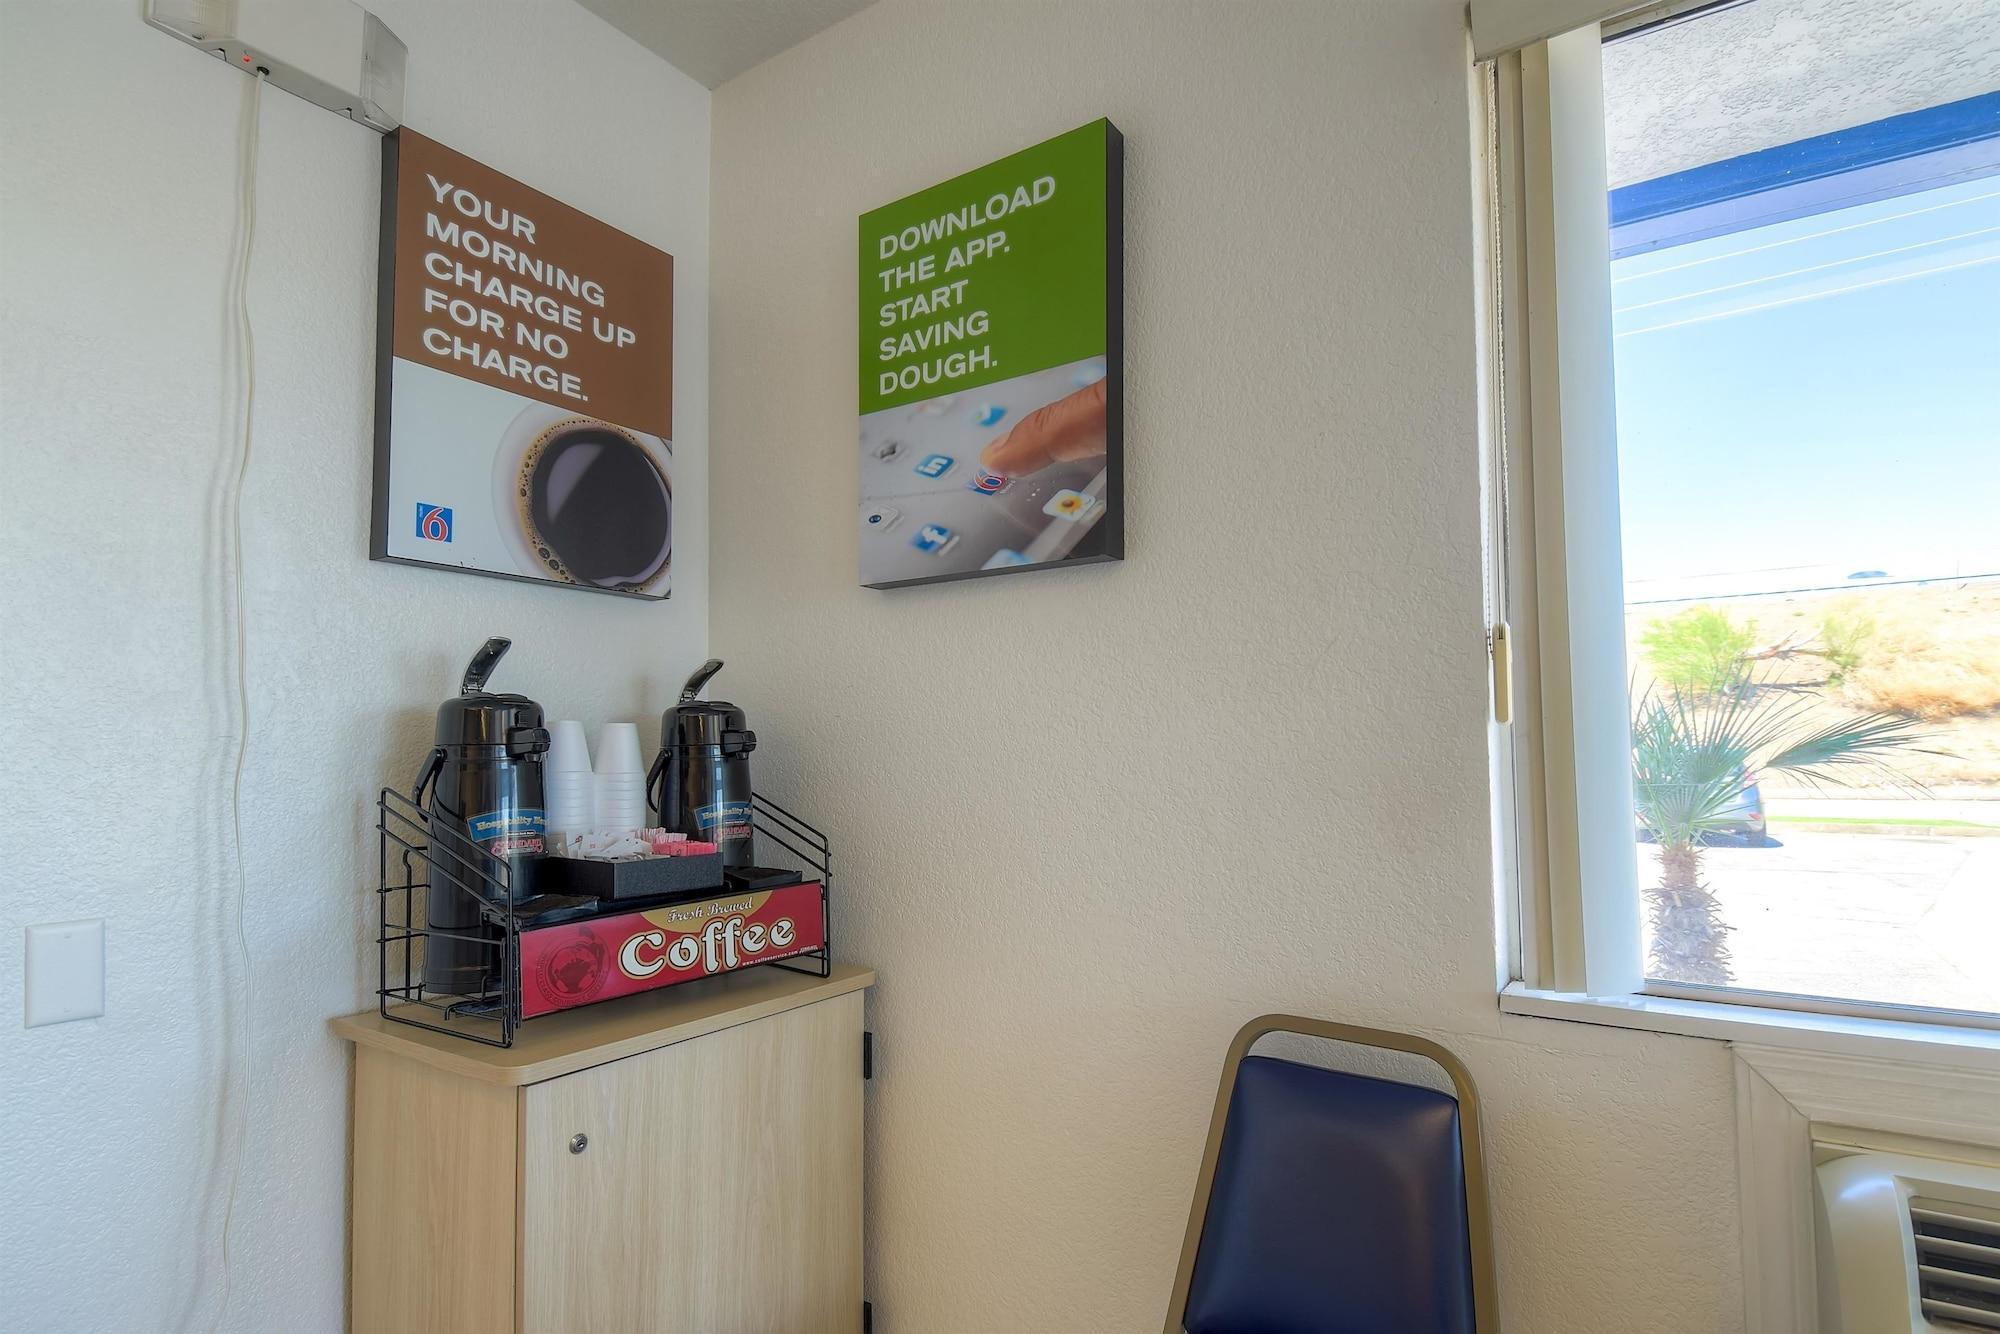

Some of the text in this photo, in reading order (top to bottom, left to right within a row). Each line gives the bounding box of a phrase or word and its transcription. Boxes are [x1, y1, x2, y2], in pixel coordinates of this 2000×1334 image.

[426, 173, 536, 245] YOUR
[879, 175, 1056, 260] DOWNLOAD
[426, 212, 605, 308] MORNING
[878, 230, 1010, 292] THE APP.
[424, 252, 636, 348] CHARGE UP
[424, 287, 569, 359] FOR NO
[879, 279, 969, 327] START
[423, 327, 588, 402] CHARGE.
[879, 310, 989, 361] SAVING
[879, 345, 998, 395] DOUGH.
[421, 507, 449, 543] 6
[667, 896, 753, 923] Fresh Brewed
[620, 916, 795, 977] Coffee
